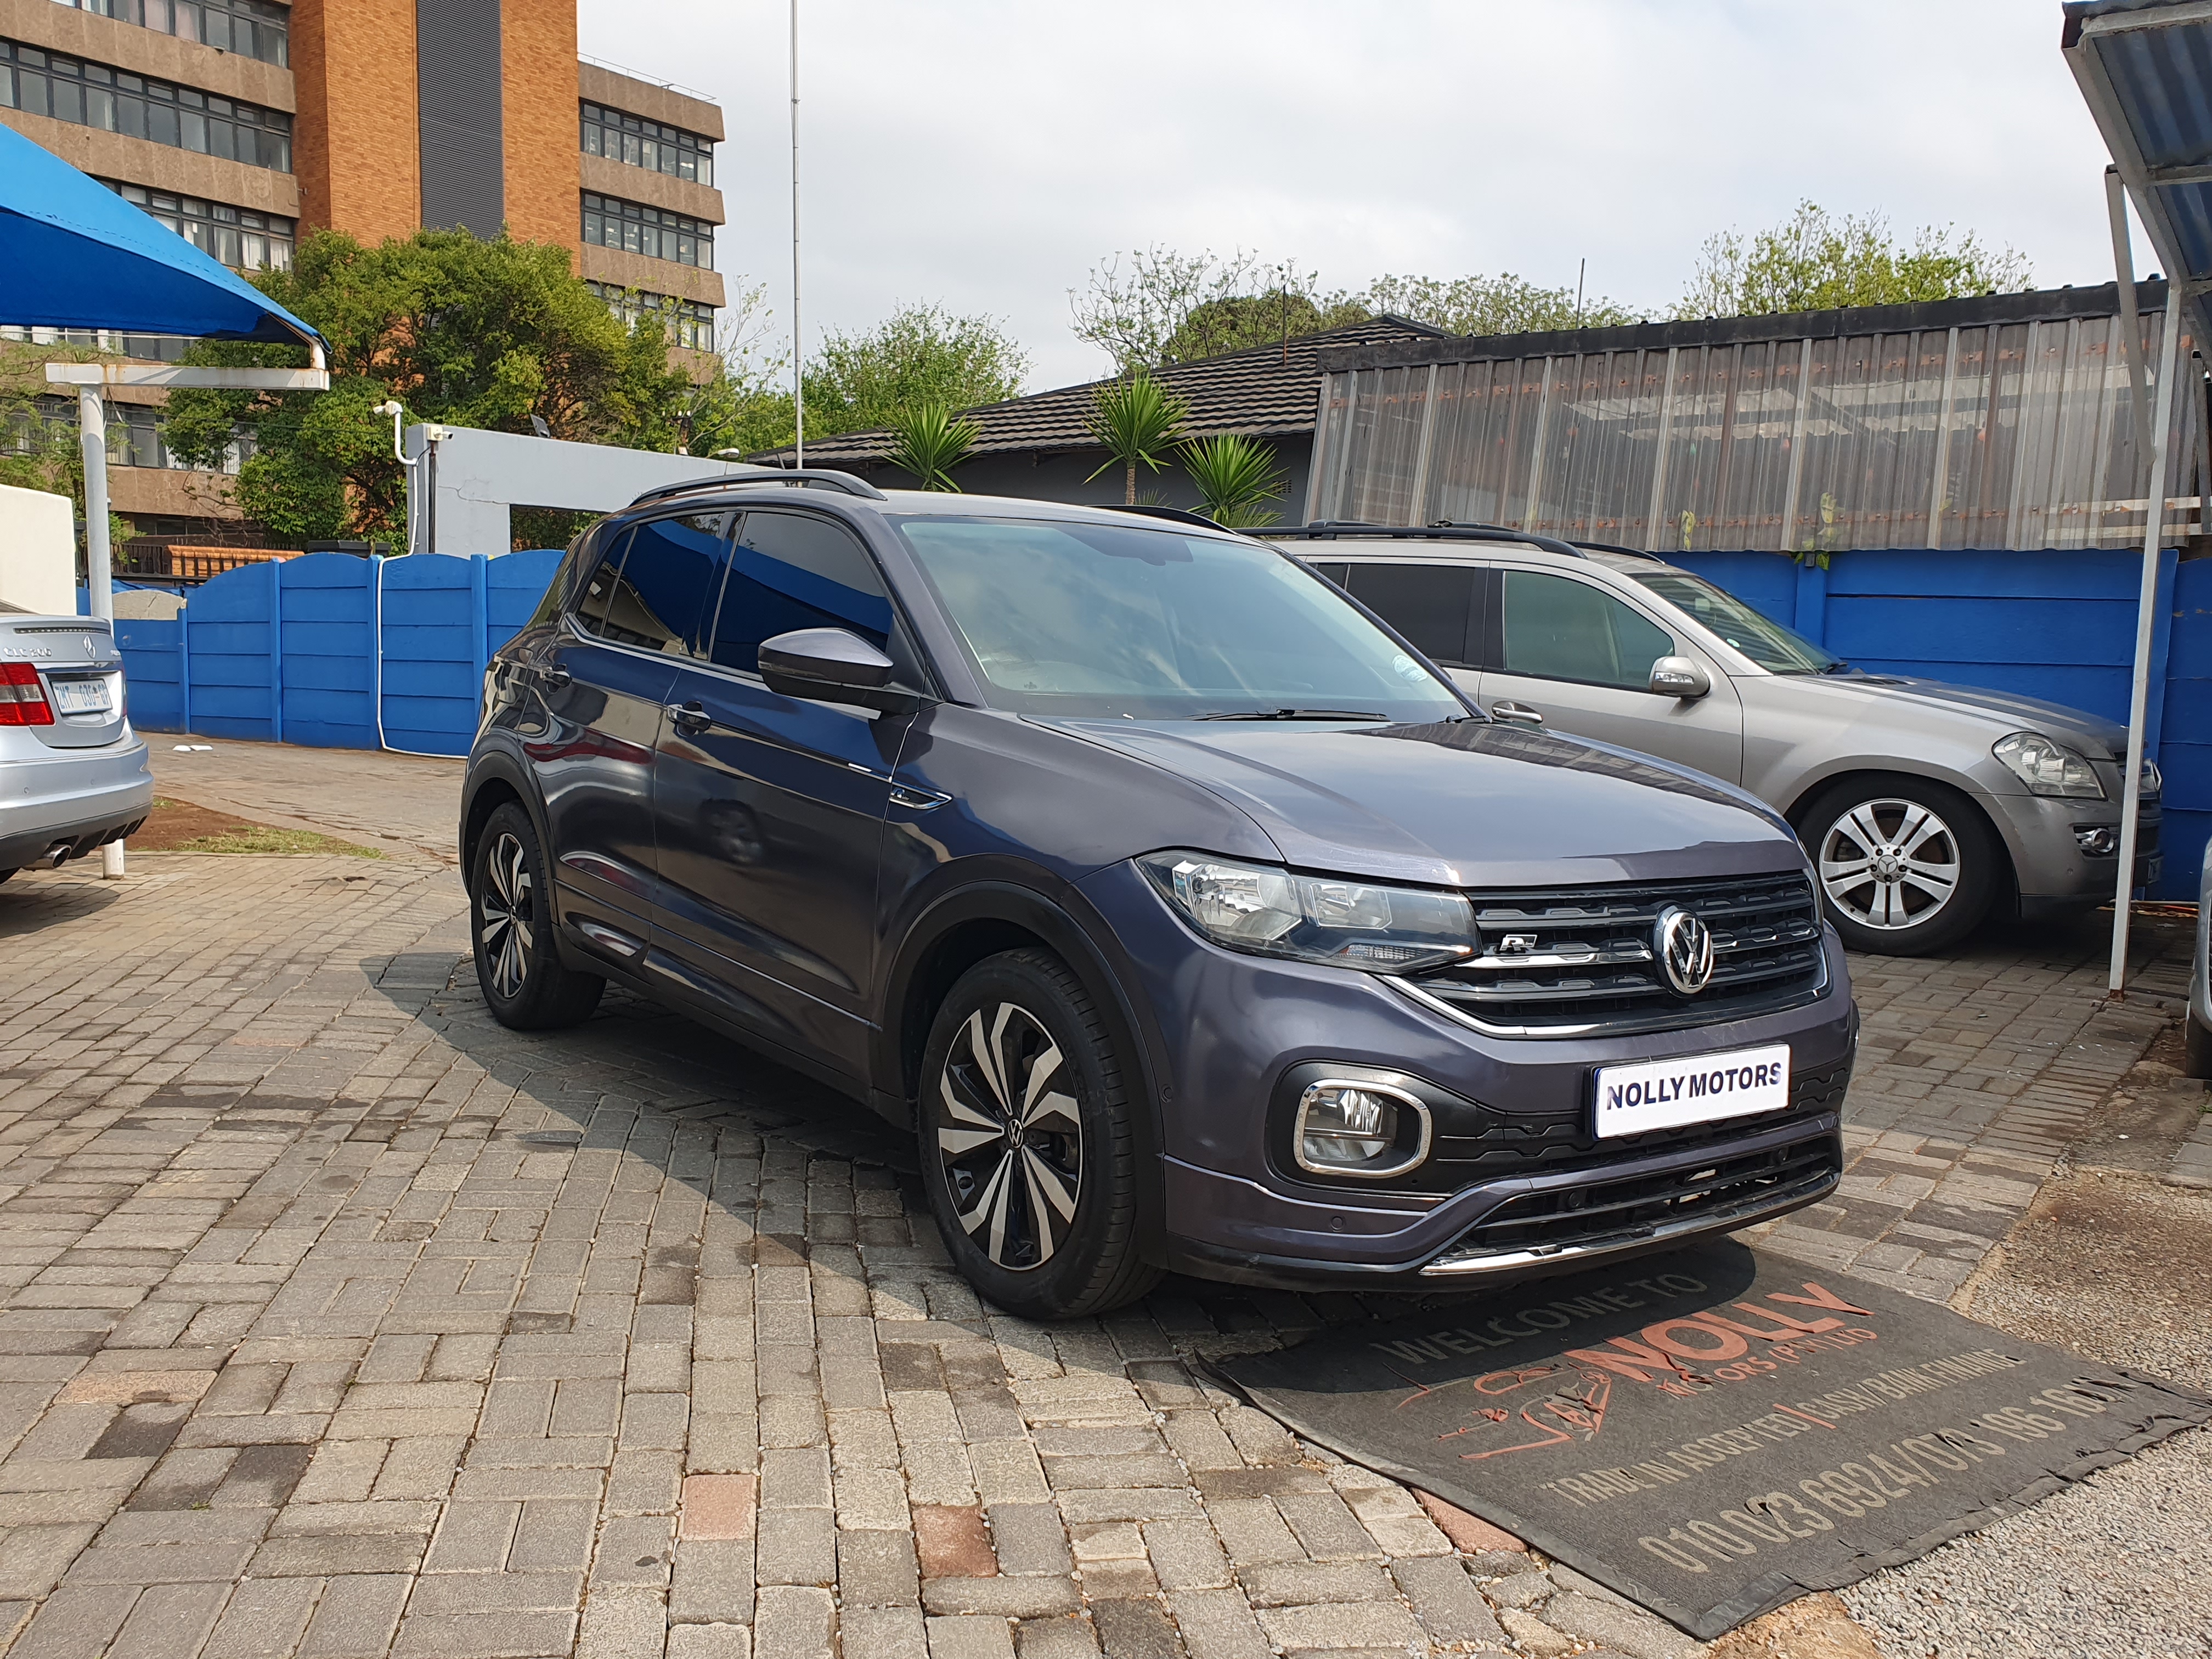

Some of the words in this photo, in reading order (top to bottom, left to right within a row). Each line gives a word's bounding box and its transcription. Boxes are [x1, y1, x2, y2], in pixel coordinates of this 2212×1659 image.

[3, 647, 27, 657] CLC
[1607, 1076, 1685, 1110] NOLLY
[1689, 1062, 1781, 1098] MOTORS
[1369, 1287, 1644, 1364] WELCOME
[1632, 1273, 1707, 1298] TO
[1564, 1281, 1875, 1382] NOLLY
[1630, 1459, 1690, 1482] IN
[1667, 1412, 1812, 1472] ACCEPTED
[1638, 1520, 1757, 1573] 010
[1719, 1491, 1835, 1543] 023
[1970, 1406, 2067, 1443] 196
